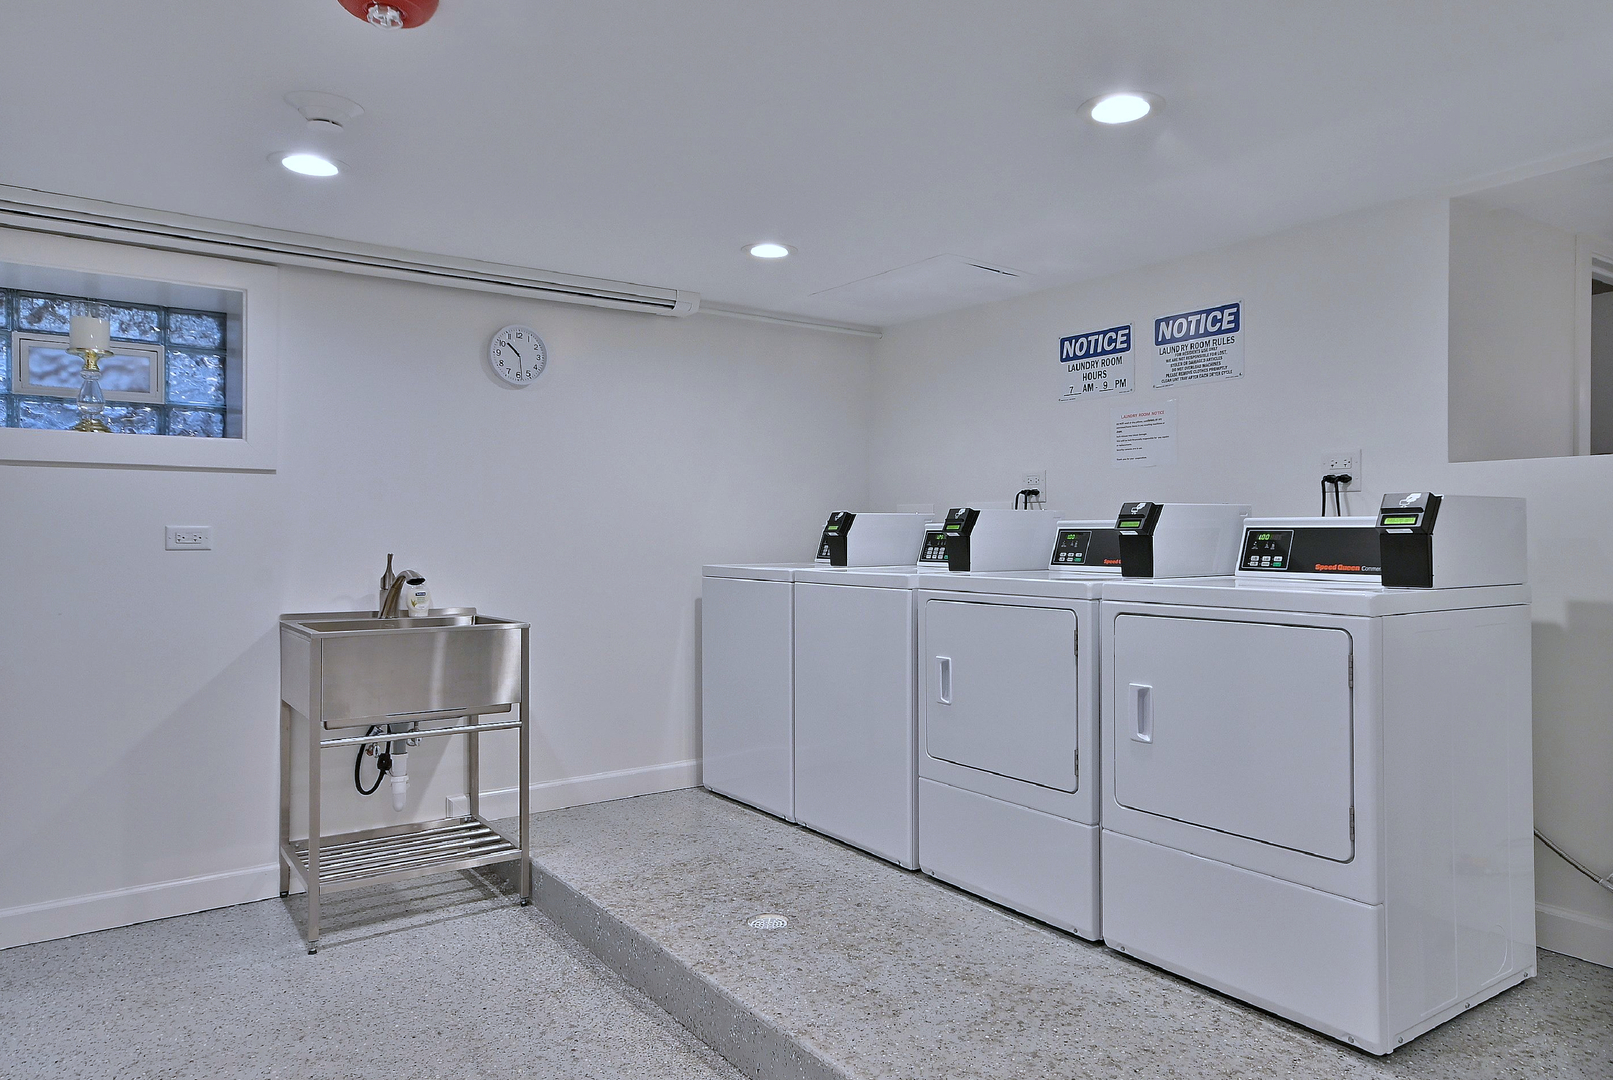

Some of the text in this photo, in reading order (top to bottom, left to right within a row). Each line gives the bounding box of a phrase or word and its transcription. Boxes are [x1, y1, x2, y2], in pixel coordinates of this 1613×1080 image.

[1158, 308, 1238, 341] NOTICE
[1062, 329, 1129, 358] NOTICE
[1159, 336, 1235, 355] LAUNDRY ROOM RULES
[1068, 356, 1122, 372] LAUNDRY ROOM
[1083, 370, 1107, 381] HOURS
[1083, 383, 1094, 392] AM
[1103, 381, 1108, 389] 9
[1115, 379, 1126, 388] PM
